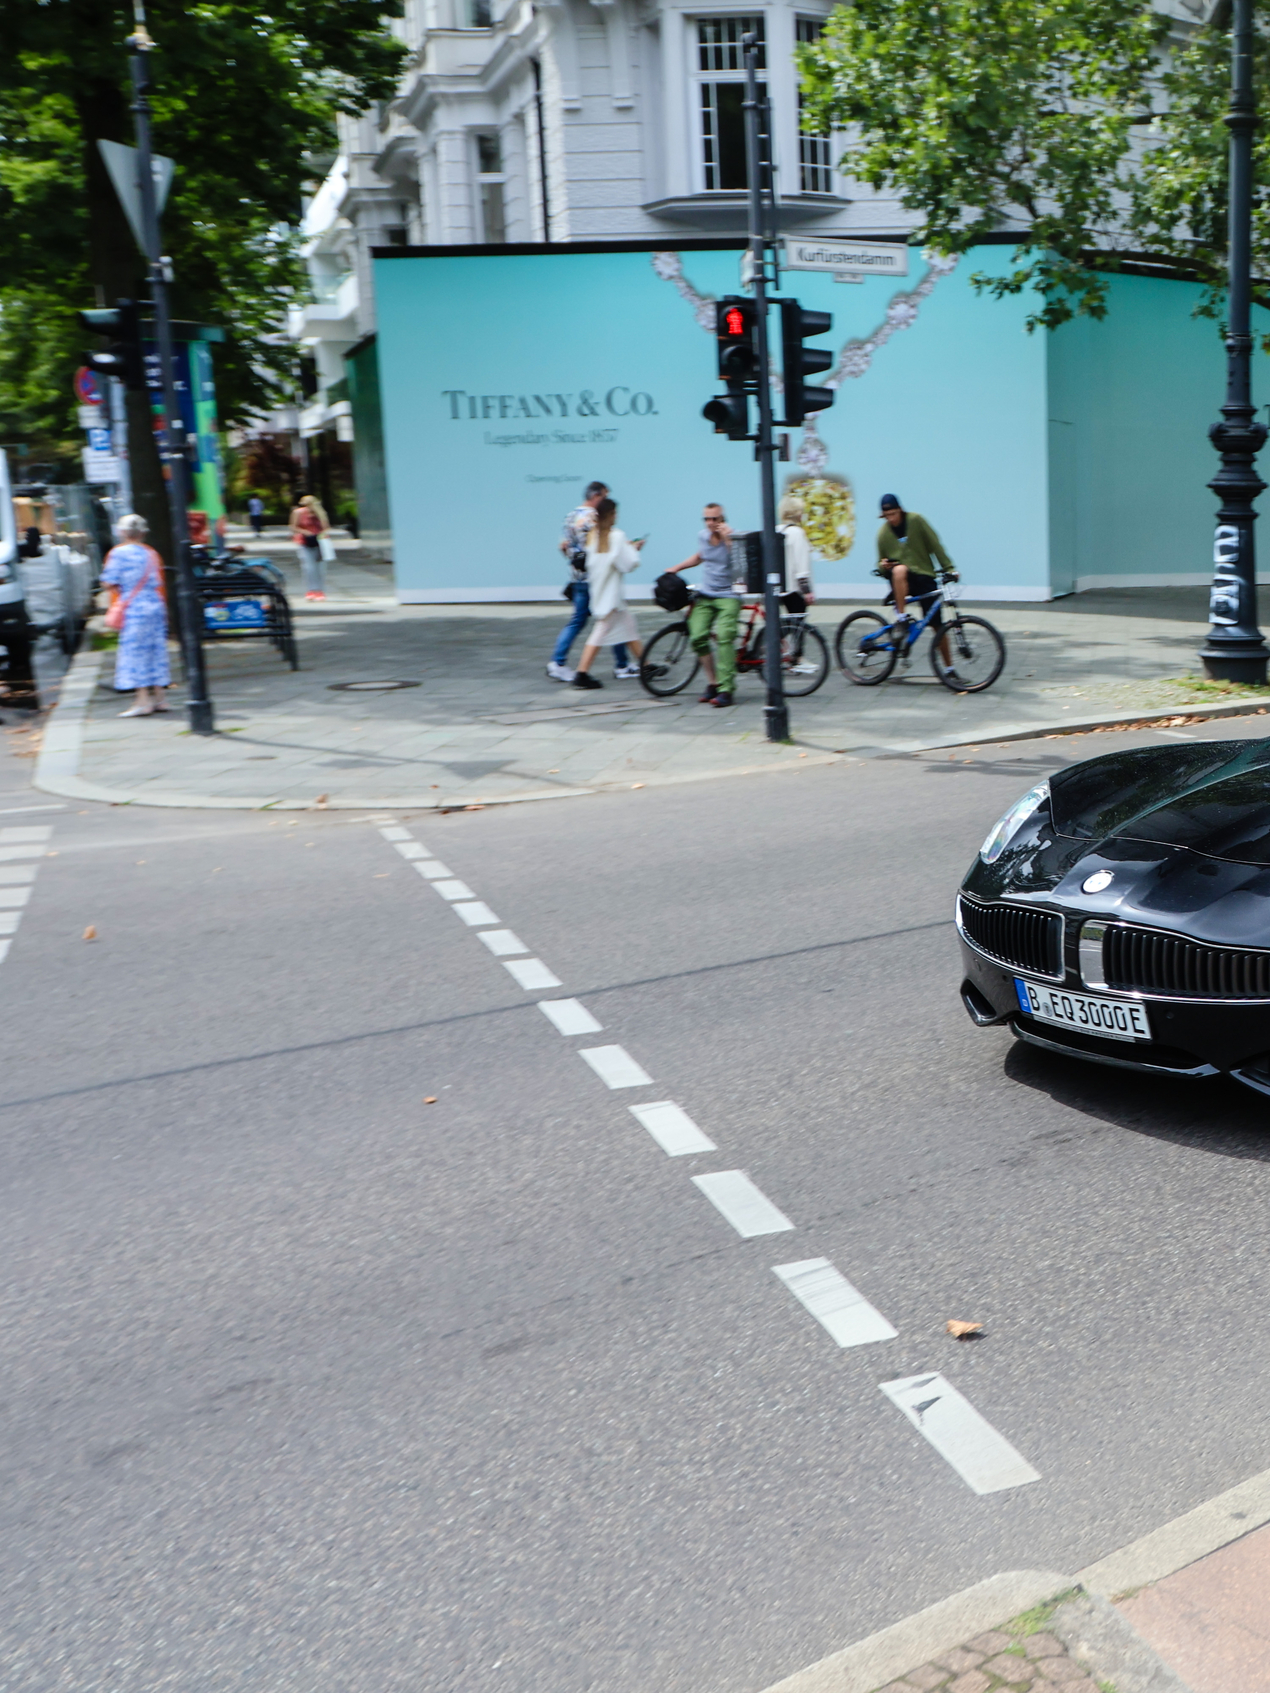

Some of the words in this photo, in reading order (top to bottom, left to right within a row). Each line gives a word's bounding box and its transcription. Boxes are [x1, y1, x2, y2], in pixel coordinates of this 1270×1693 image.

[441, 389, 574, 419] TIFFANY
[576, 389, 601, 417] &
[1028, 986, 1041, 1012] B
